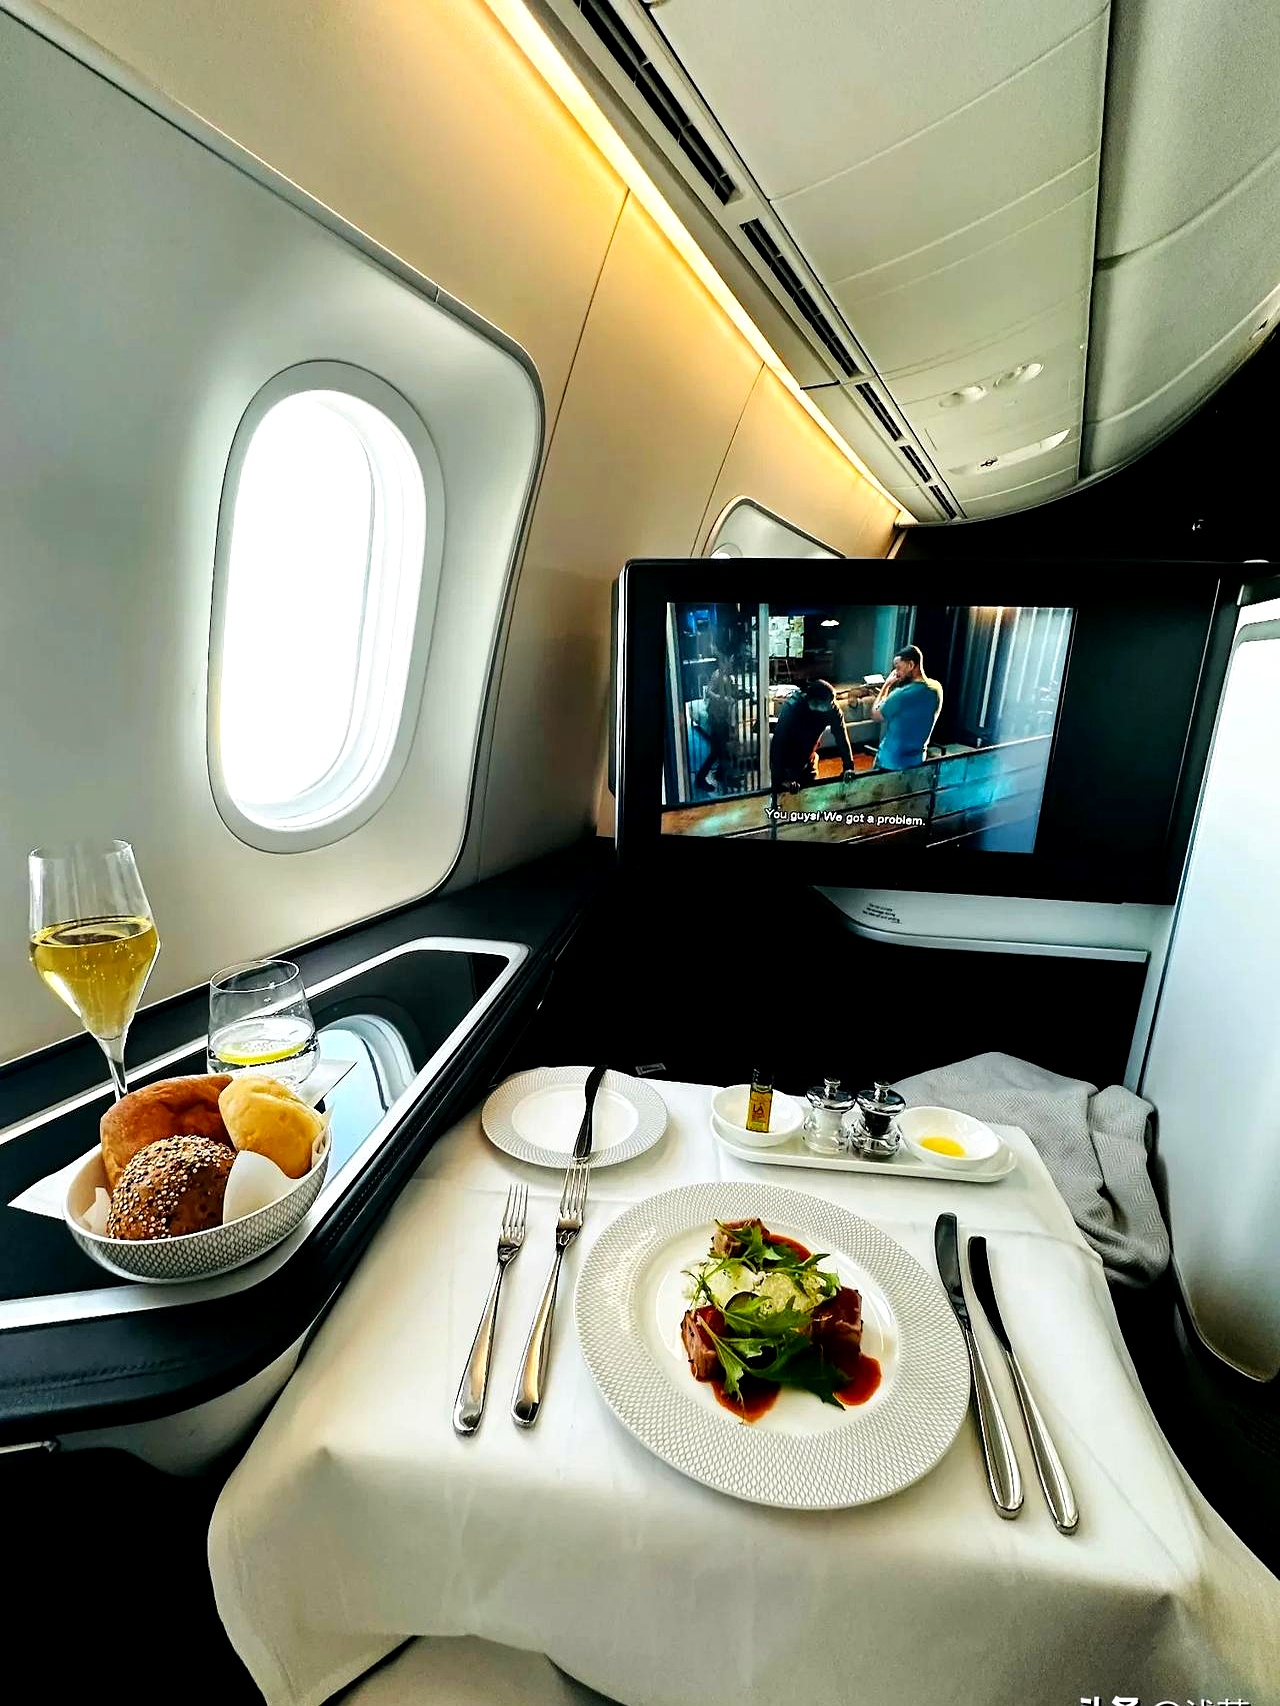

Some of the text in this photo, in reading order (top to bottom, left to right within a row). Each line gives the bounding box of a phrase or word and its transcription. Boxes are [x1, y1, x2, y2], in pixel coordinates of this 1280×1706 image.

[765, 808, 926, 827] You guys! We got a problem.
